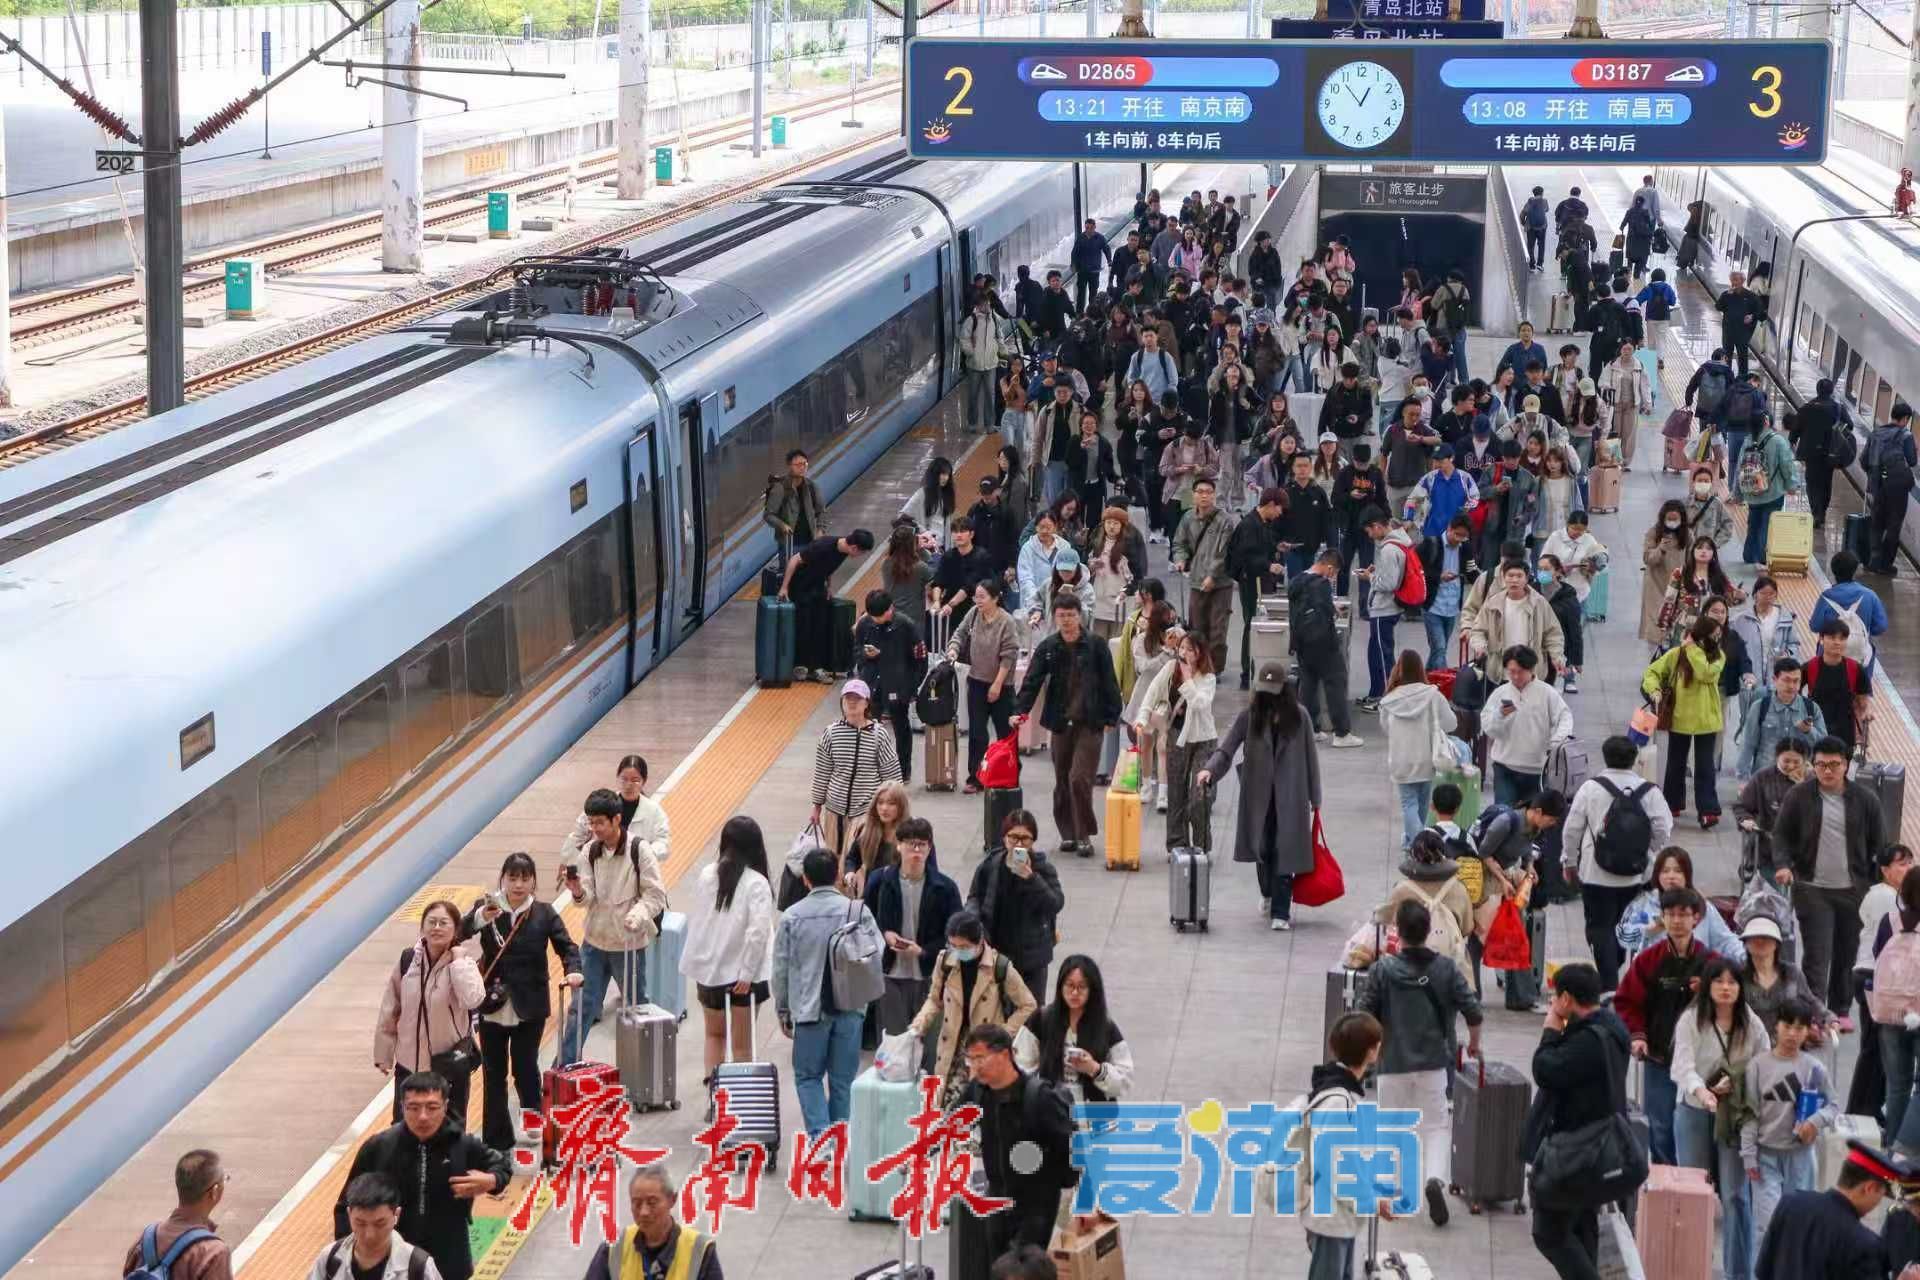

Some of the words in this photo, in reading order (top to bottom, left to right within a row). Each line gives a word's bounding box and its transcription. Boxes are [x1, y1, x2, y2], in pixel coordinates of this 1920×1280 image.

[1364, 0, 1444, 16] 青岛北站
[1079, 63, 1136, 80] D2865
[1342, 71, 1349, 83] 11
[1357, 66, 1367, 77] 12
[1592, 63, 1652, 81] D3187
[944, 66, 974, 115] 2
[1329, 83, 1340, 94] 10
[1384, 83, 1393, 94] 2
[1749, 65, 1782, 118] 3
[1055, 98, 1105, 115] 13:21
[1122, 97, 1166, 117] 开往
[1180, 96, 1245, 117] 南京南
[1324, 98, 1331, 109] 9
[1390, 99, 1398, 110] 3
[1471, 101, 1526, 118] 13:08
[1545, 99, 1589, 120] 开往
[1607, 97, 1674, 119] 南昌西
[1328, 114, 1336, 125] 8
[1383, 116, 1391, 127] 4
[1342, 126, 1350, 137] 7
[1355, 130, 1363, 141] 6
[1372, 127, 1379, 138] 5
[97, 156, 135, 171] 202
[1389, 181, 1445, 197] 旅客止步
